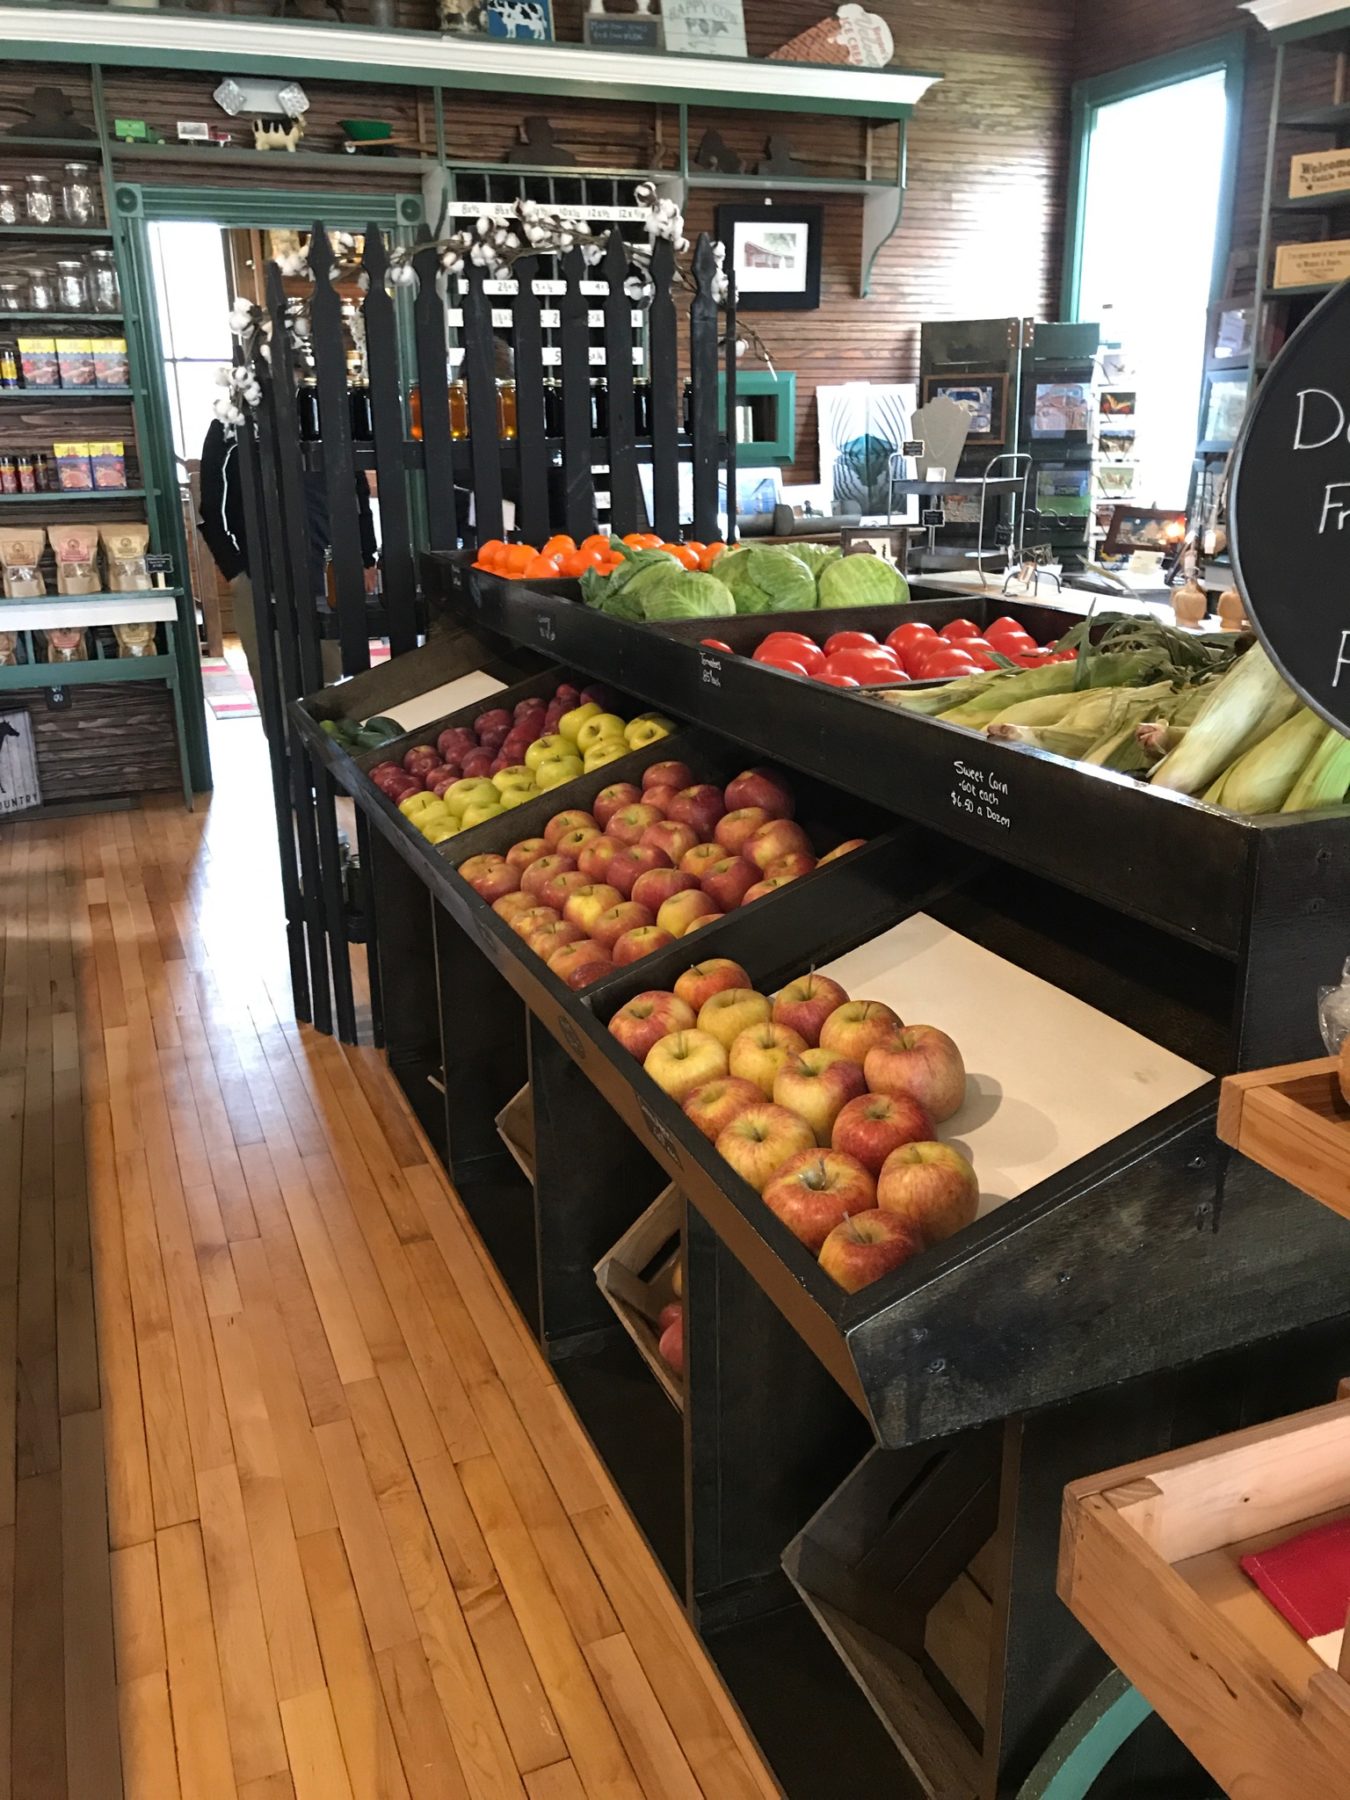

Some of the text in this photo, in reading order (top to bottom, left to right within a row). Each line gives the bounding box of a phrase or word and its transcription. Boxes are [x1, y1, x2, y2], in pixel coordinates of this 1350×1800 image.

[953, 760, 1009, 795] Sweet Corn
[979, 789, 1000, 806] each
[976, 806, 983, 817] a
[986, 806, 1010, 828] Dozen
